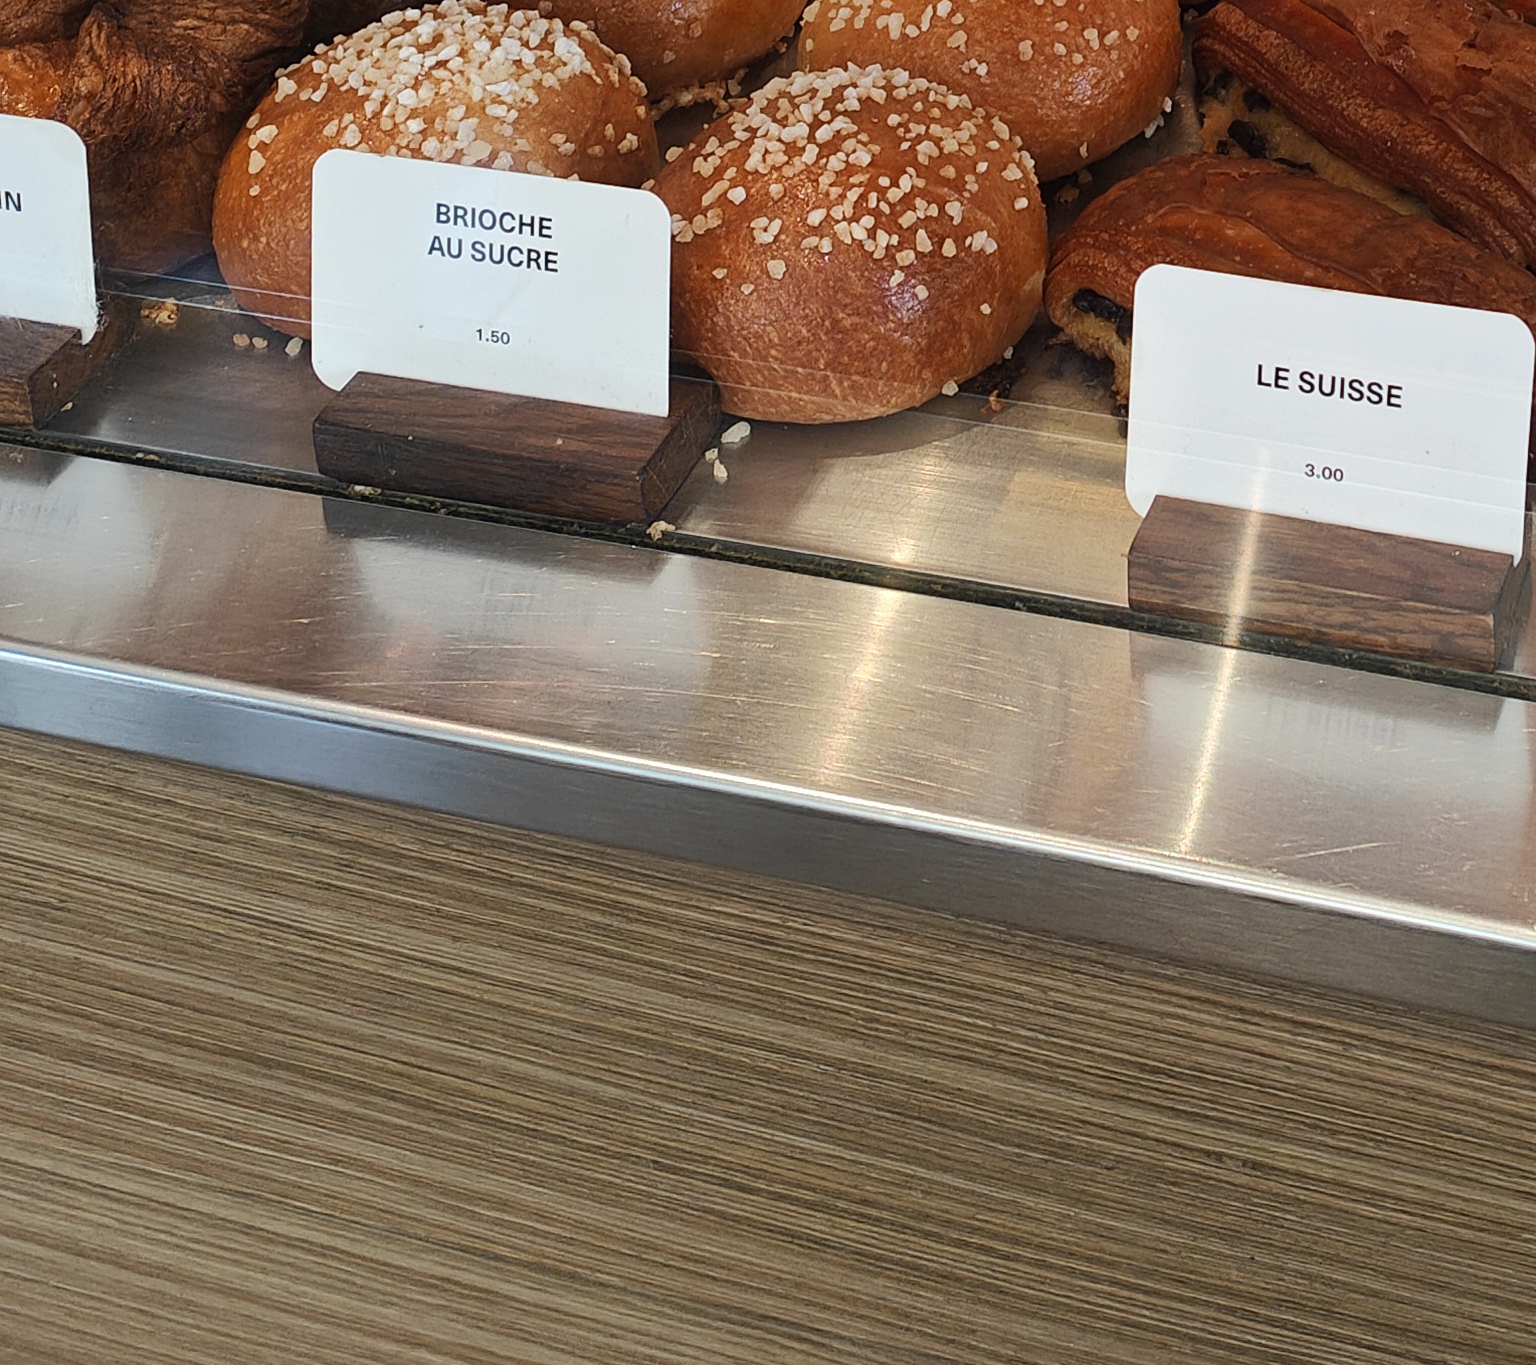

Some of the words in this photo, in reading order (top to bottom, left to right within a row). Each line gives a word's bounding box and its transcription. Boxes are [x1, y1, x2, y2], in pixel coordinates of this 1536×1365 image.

[434, 202, 554, 240] BRIOCHE
[427, 235, 463, 260] AU
[470, 239, 560, 274] SUCRE
[475, 328, 511, 346] 1.50
[1257, 364, 1290, 390] LE
[1298, 371, 1404, 409] SUISSE
[1304, 463, 1344, 482] 3.00
